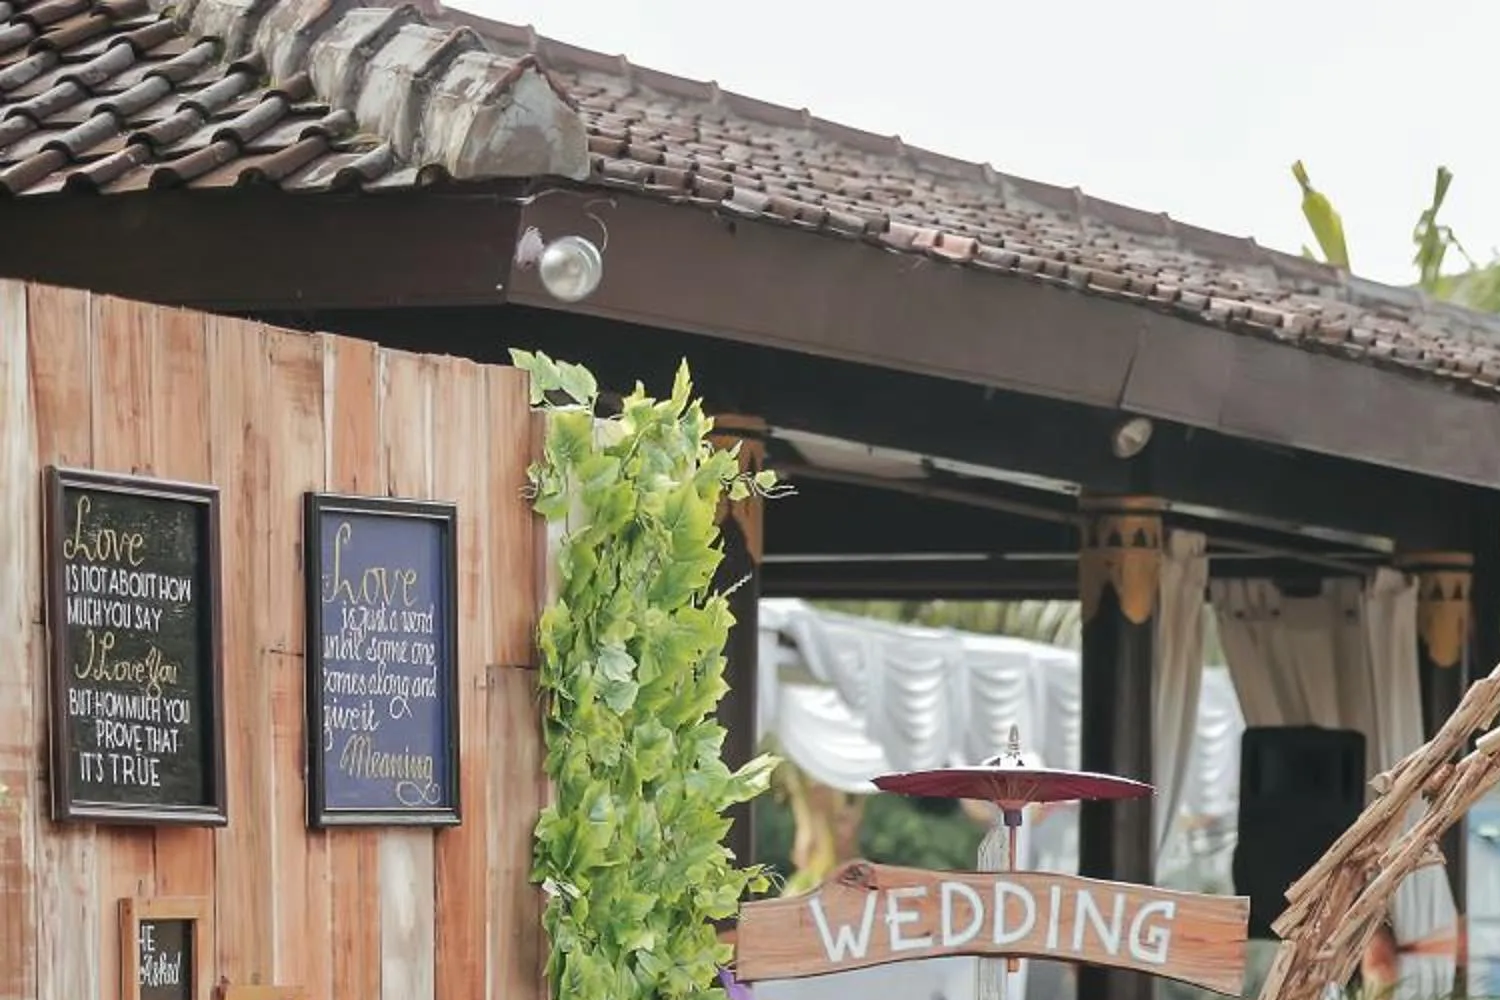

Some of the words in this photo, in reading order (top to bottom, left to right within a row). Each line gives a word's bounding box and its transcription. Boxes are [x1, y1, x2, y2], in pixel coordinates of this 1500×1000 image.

[63, 495, 145, 567] Love
[65, 564, 79, 593] IS
[81, 565, 107, 595] NOT
[108, 568, 157, 599] ABOUT
[159, 575, 191, 602] HOW
[322, 522, 418, 608] Love
[67, 596, 102, 626] MUCH
[103, 600, 131, 629] YOU
[135, 604, 163, 633] SAY
[93, 631, 145, 683] Love
[145, 645, 177, 700] You
[411, 665, 437, 698] and
[68, 687, 92, 716] BUT
[95, 691, 125, 718] HOW
[125, 694, 161, 723] MUCH
[163, 699, 191, 725] YOU
[96, 719, 143, 751] PROVE
[145, 726, 179, 753] THAT
[108, 753, 161, 787] TRUE
[340, 734, 440, 806] Meaning
[808, 881, 1175, 964] WEDDING
